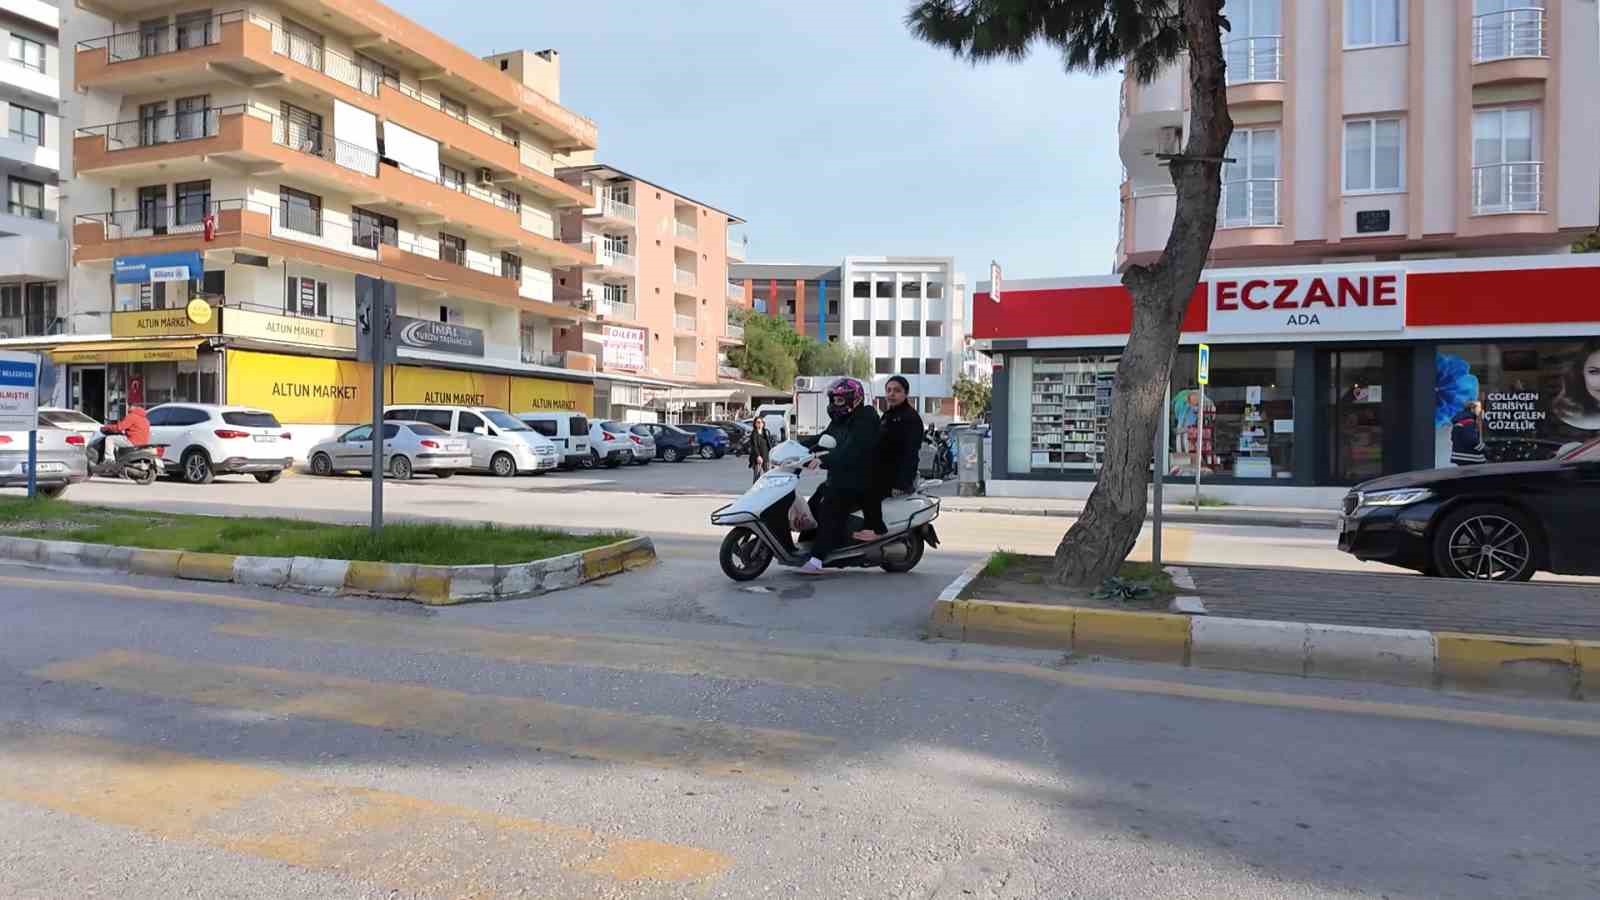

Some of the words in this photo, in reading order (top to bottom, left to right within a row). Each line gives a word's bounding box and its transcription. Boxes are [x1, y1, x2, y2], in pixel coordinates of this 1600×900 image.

[1216, 275, 1397, 311] ECZANE
[137, 318, 159, 329] ALTUN
[161, 317, 189, 329] MARKET
[1286, 314, 1320, 326] ADA
[265, 320, 292, 334] ALTUN
[293, 325, 324, 338] MARKET
[272, 381, 310, 397] ALTUN
[312, 384, 357, 400] MARKET
[1487, 392, 1539, 401] COLLAGEN
[424, 391, 452, 404] ALTUN
[453, 393, 485, 406] MARKET
[532, 398, 552, 409] ALTUN
[553, 399, 576, 409] MARKET
[1491, 401, 1535, 411] SERİSİYLE
[1513, 411, 1546, 420] GELEN
[1488, 419, 1536, 431] GÜZELLİK
